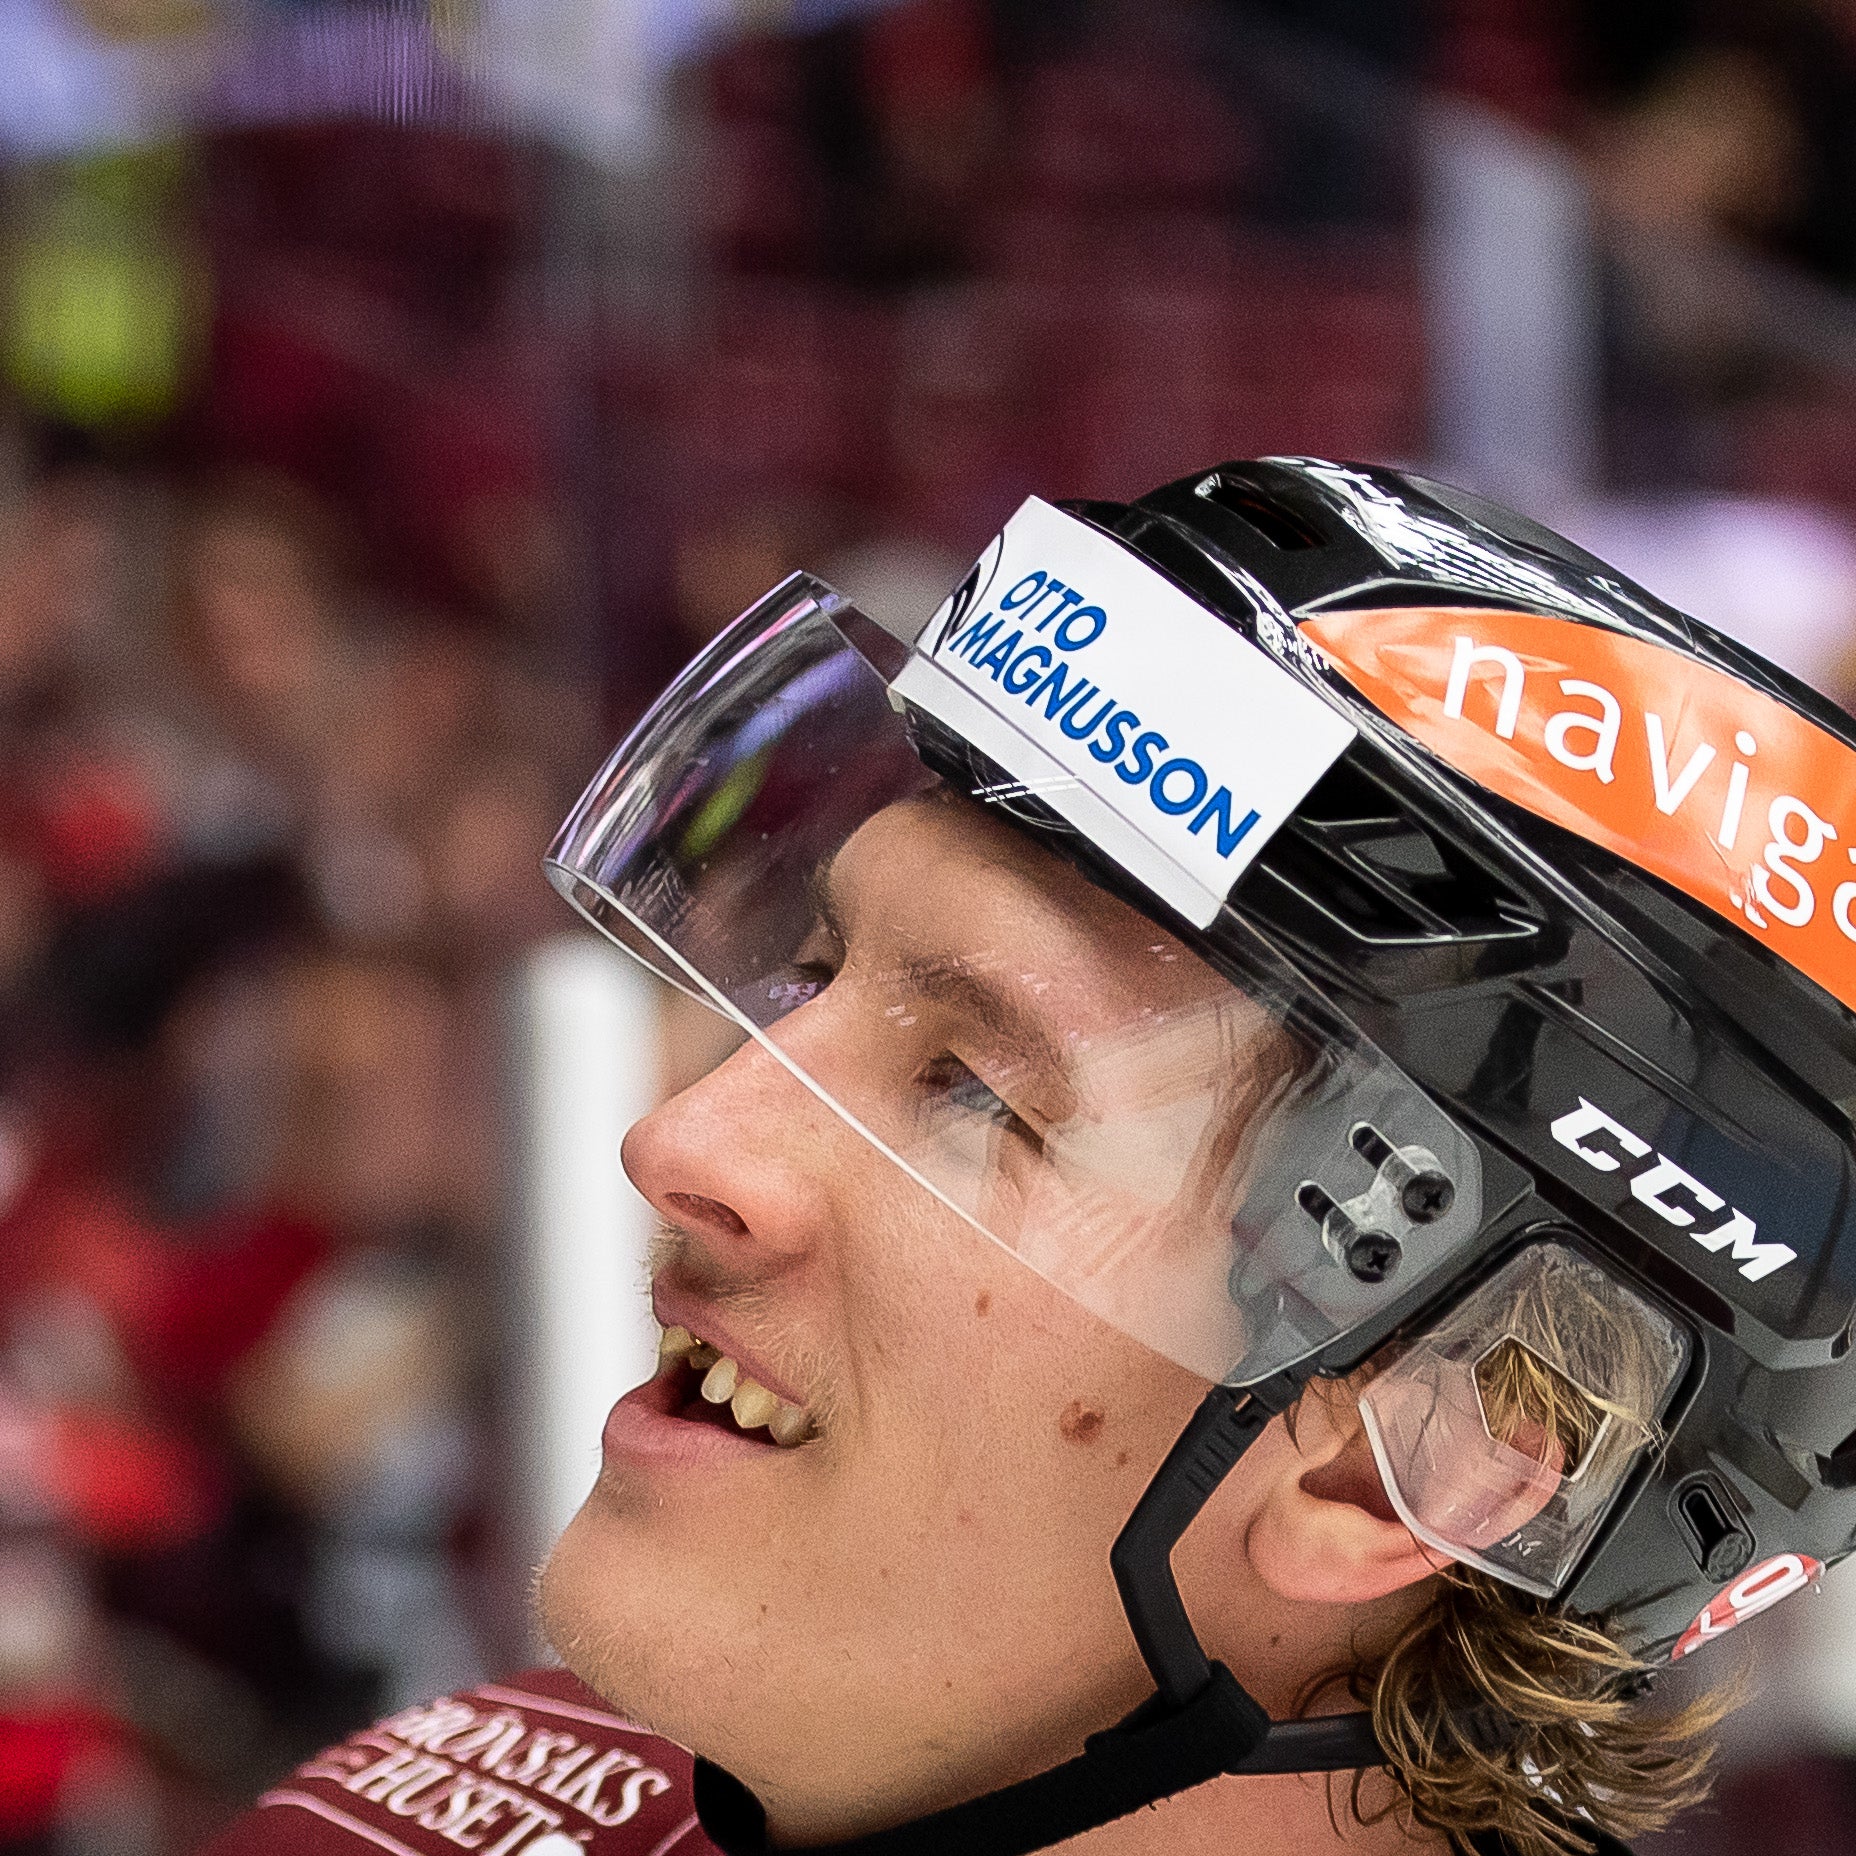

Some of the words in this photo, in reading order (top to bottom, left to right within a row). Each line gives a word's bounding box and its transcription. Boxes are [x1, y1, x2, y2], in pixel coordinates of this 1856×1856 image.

[999, 570, 1107, 651] OTTO
[948, 612, 1261, 858] MAGNUSSON
[1549, 1096, 1797, 1283] CCM
